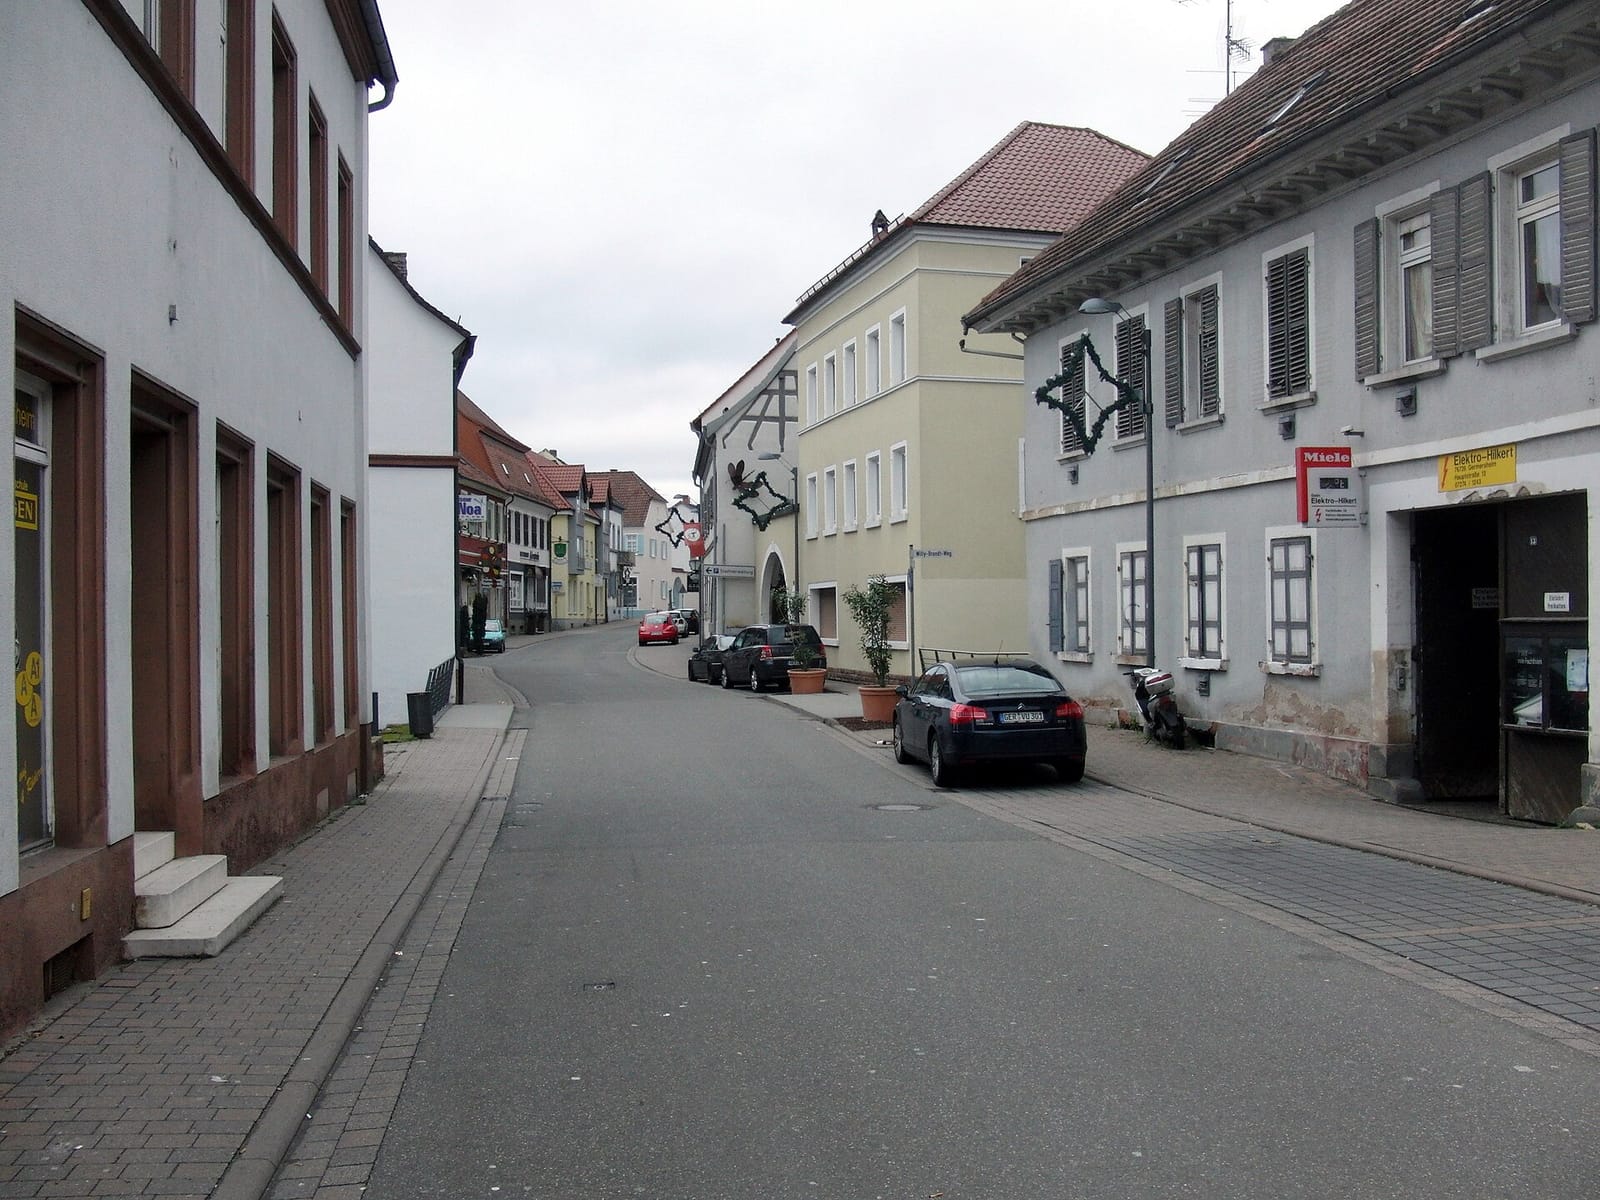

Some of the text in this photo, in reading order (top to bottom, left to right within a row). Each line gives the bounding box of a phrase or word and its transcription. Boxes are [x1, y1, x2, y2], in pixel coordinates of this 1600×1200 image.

[1304, 452, 1350, 463] Miele
[1454, 447, 1514, 465] Elektro-Hilkert
[459, 502, 481, 515] Noa
[1004, 713, 1017, 721] GER
